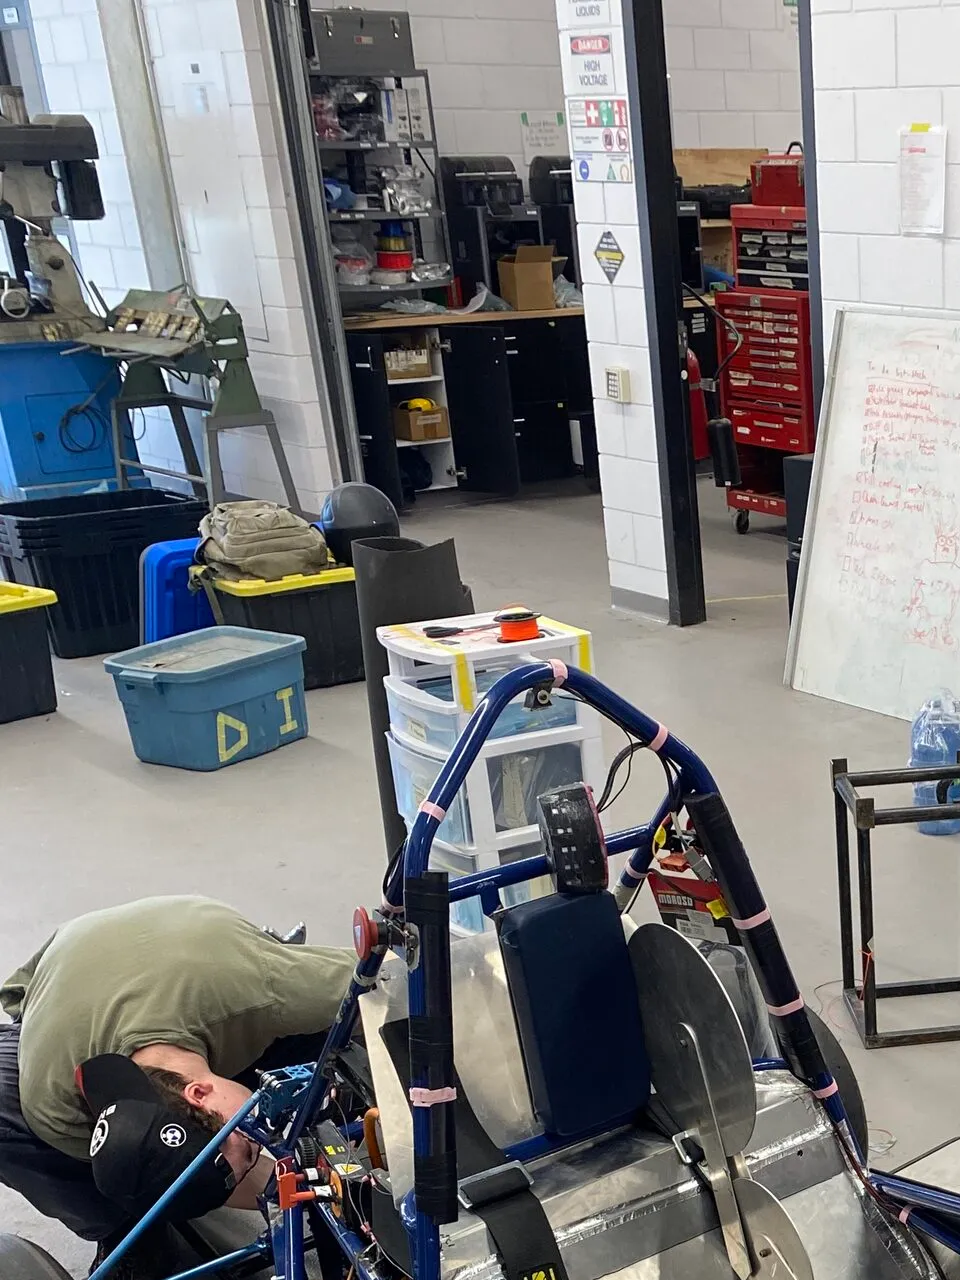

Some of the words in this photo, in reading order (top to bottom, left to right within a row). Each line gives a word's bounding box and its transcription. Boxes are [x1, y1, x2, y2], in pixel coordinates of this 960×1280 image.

[576, 5, 600, 16] LIQUIDS
[584, 60, 600, 71] HIGH
[579, 75, 608, 86] VOLTAGE
[216, 711, 249, 763] D
[658, 893, 694, 907] MOROSO
